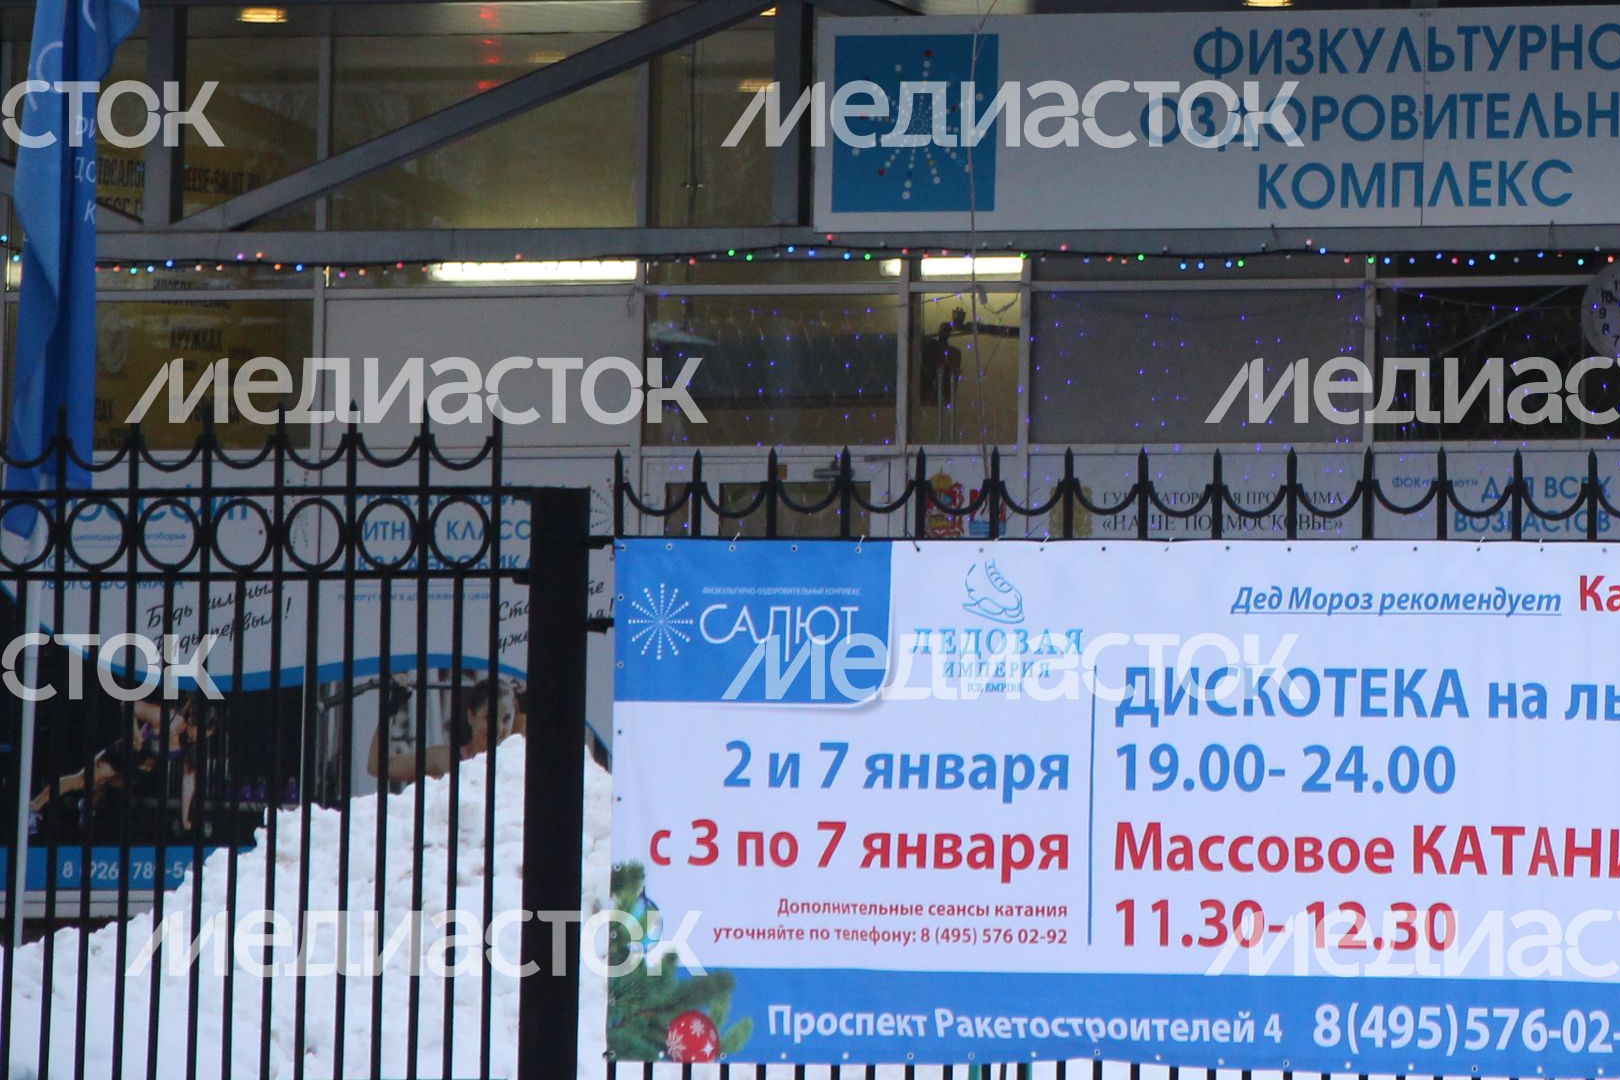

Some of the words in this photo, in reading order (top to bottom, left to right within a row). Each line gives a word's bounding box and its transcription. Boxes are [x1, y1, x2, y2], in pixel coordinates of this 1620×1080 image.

[1257, 159, 1574, 211] КОМПЛЕКС
[1230, 586, 1283, 614] Дед
[1287, 586, 1374, 616] Мороз
[1378, 586, 1562, 618] рекомендует
[700, 603, 859, 662] САЛЮТ
[910, 628, 1084, 659] ЛЕДОВАЯ
[942, 661, 1050, 678] ИМПЕРИЯ
[1115, 666, 1470, 728] ДИСКОТЕКА
[1488, 680, 1548, 720] на
[723, 740, 752, 788] 2
[768, 752, 800, 788] и
[819, 742, 850, 789] 7
[863, 753, 1069, 804] января
[1116, 743, 1286, 793] 19.00-
[1301, 745, 1456, 795] 24.00
[649, 828, 671, 866] с
[687, 819, 719, 867] 3
[737, 831, 798, 867] по
[816, 821, 848, 868] 7
[860, 832, 1069, 883] января
[1114, 822, 1394, 875] Массовое
[777, 898, 923, 918] Дополнительные
[927, 904, 990, 917] сеансы
[995, 905, 1068, 919] катания
[1115, 899, 1286, 948] 11.30-
[1306, 901, 1457, 952] 12.30
[713, 924, 803, 943] уточняйте
[809, 929, 830, 941] по
[833, 926, 917, 946] телефону:
[920, 928, 930, 942] 8
[934, 926, 977, 946] (495)
[982, 929, 1013, 943] 576
[1017, 929, 1068, 945] 02-92
[767, 1004, 928, 1044] Проспект
[934, 1007, 1256, 1044] Ракетостроителей
[1264, 1012, 1284, 1044] 4
